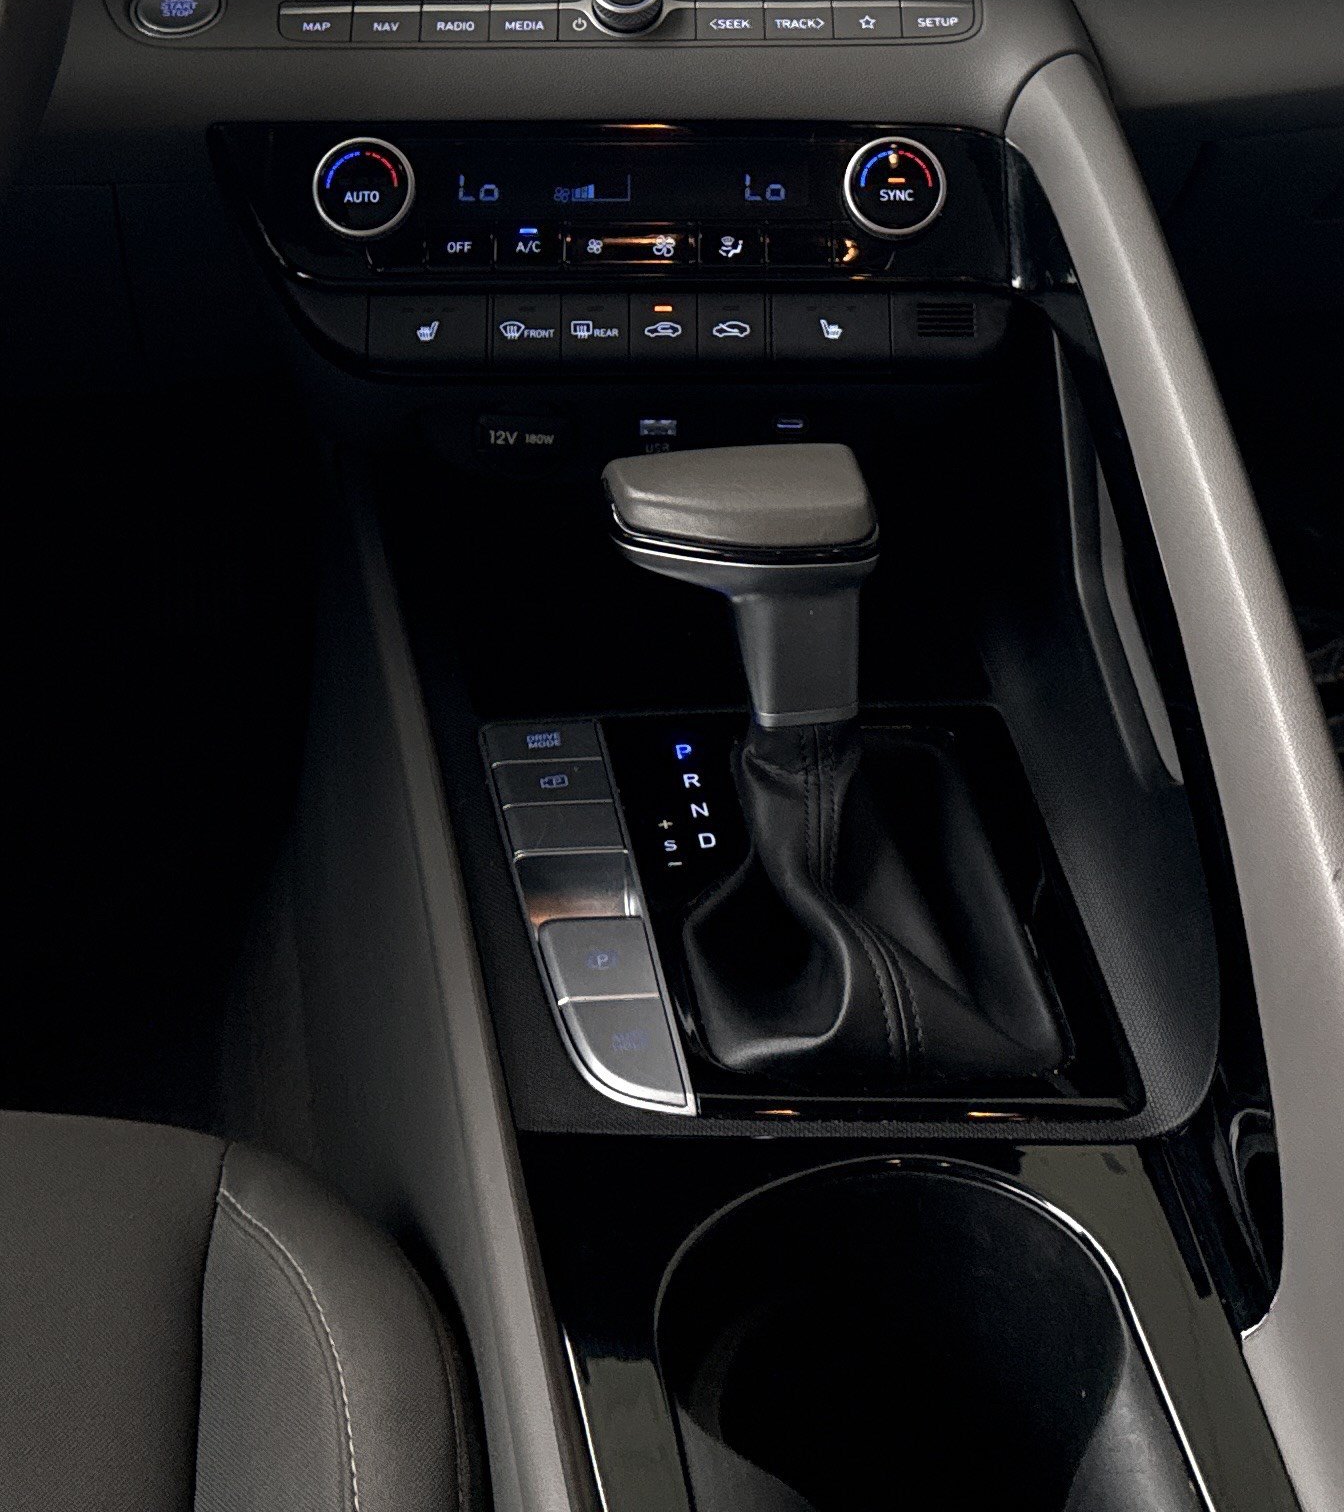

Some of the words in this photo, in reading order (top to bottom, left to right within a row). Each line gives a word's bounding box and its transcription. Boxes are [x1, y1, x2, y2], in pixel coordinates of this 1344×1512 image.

[302, 21, 331, 31] MAP
[373, 21, 400, 31] NAV
[436, 20, 475, 32] RADIO
[504, 20, 545, 31] MEDIA
[917, 16, 958, 28] SETUP
[343, 190, 380, 204] AUTO
[879, 189, 914, 202] SYNC
[446, 241, 472, 253] OFF
[516, 241, 541, 254] A/C
[524, 328, 555, 339] FRONT
[593, 328, 619, 338] REAR
[489, 430, 518, 445] 12V
[525, 433, 555, 446] 180W
[527, 732, 561, 743] DRIVE
[528, 739, 561, 749] MODE
[676, 744, 692, 760] P
[683, 773, 701, 788] R
[691, 802, 710, 818] N
[664, 840, 678, 852] S
[698, 832, 716, 848] D
